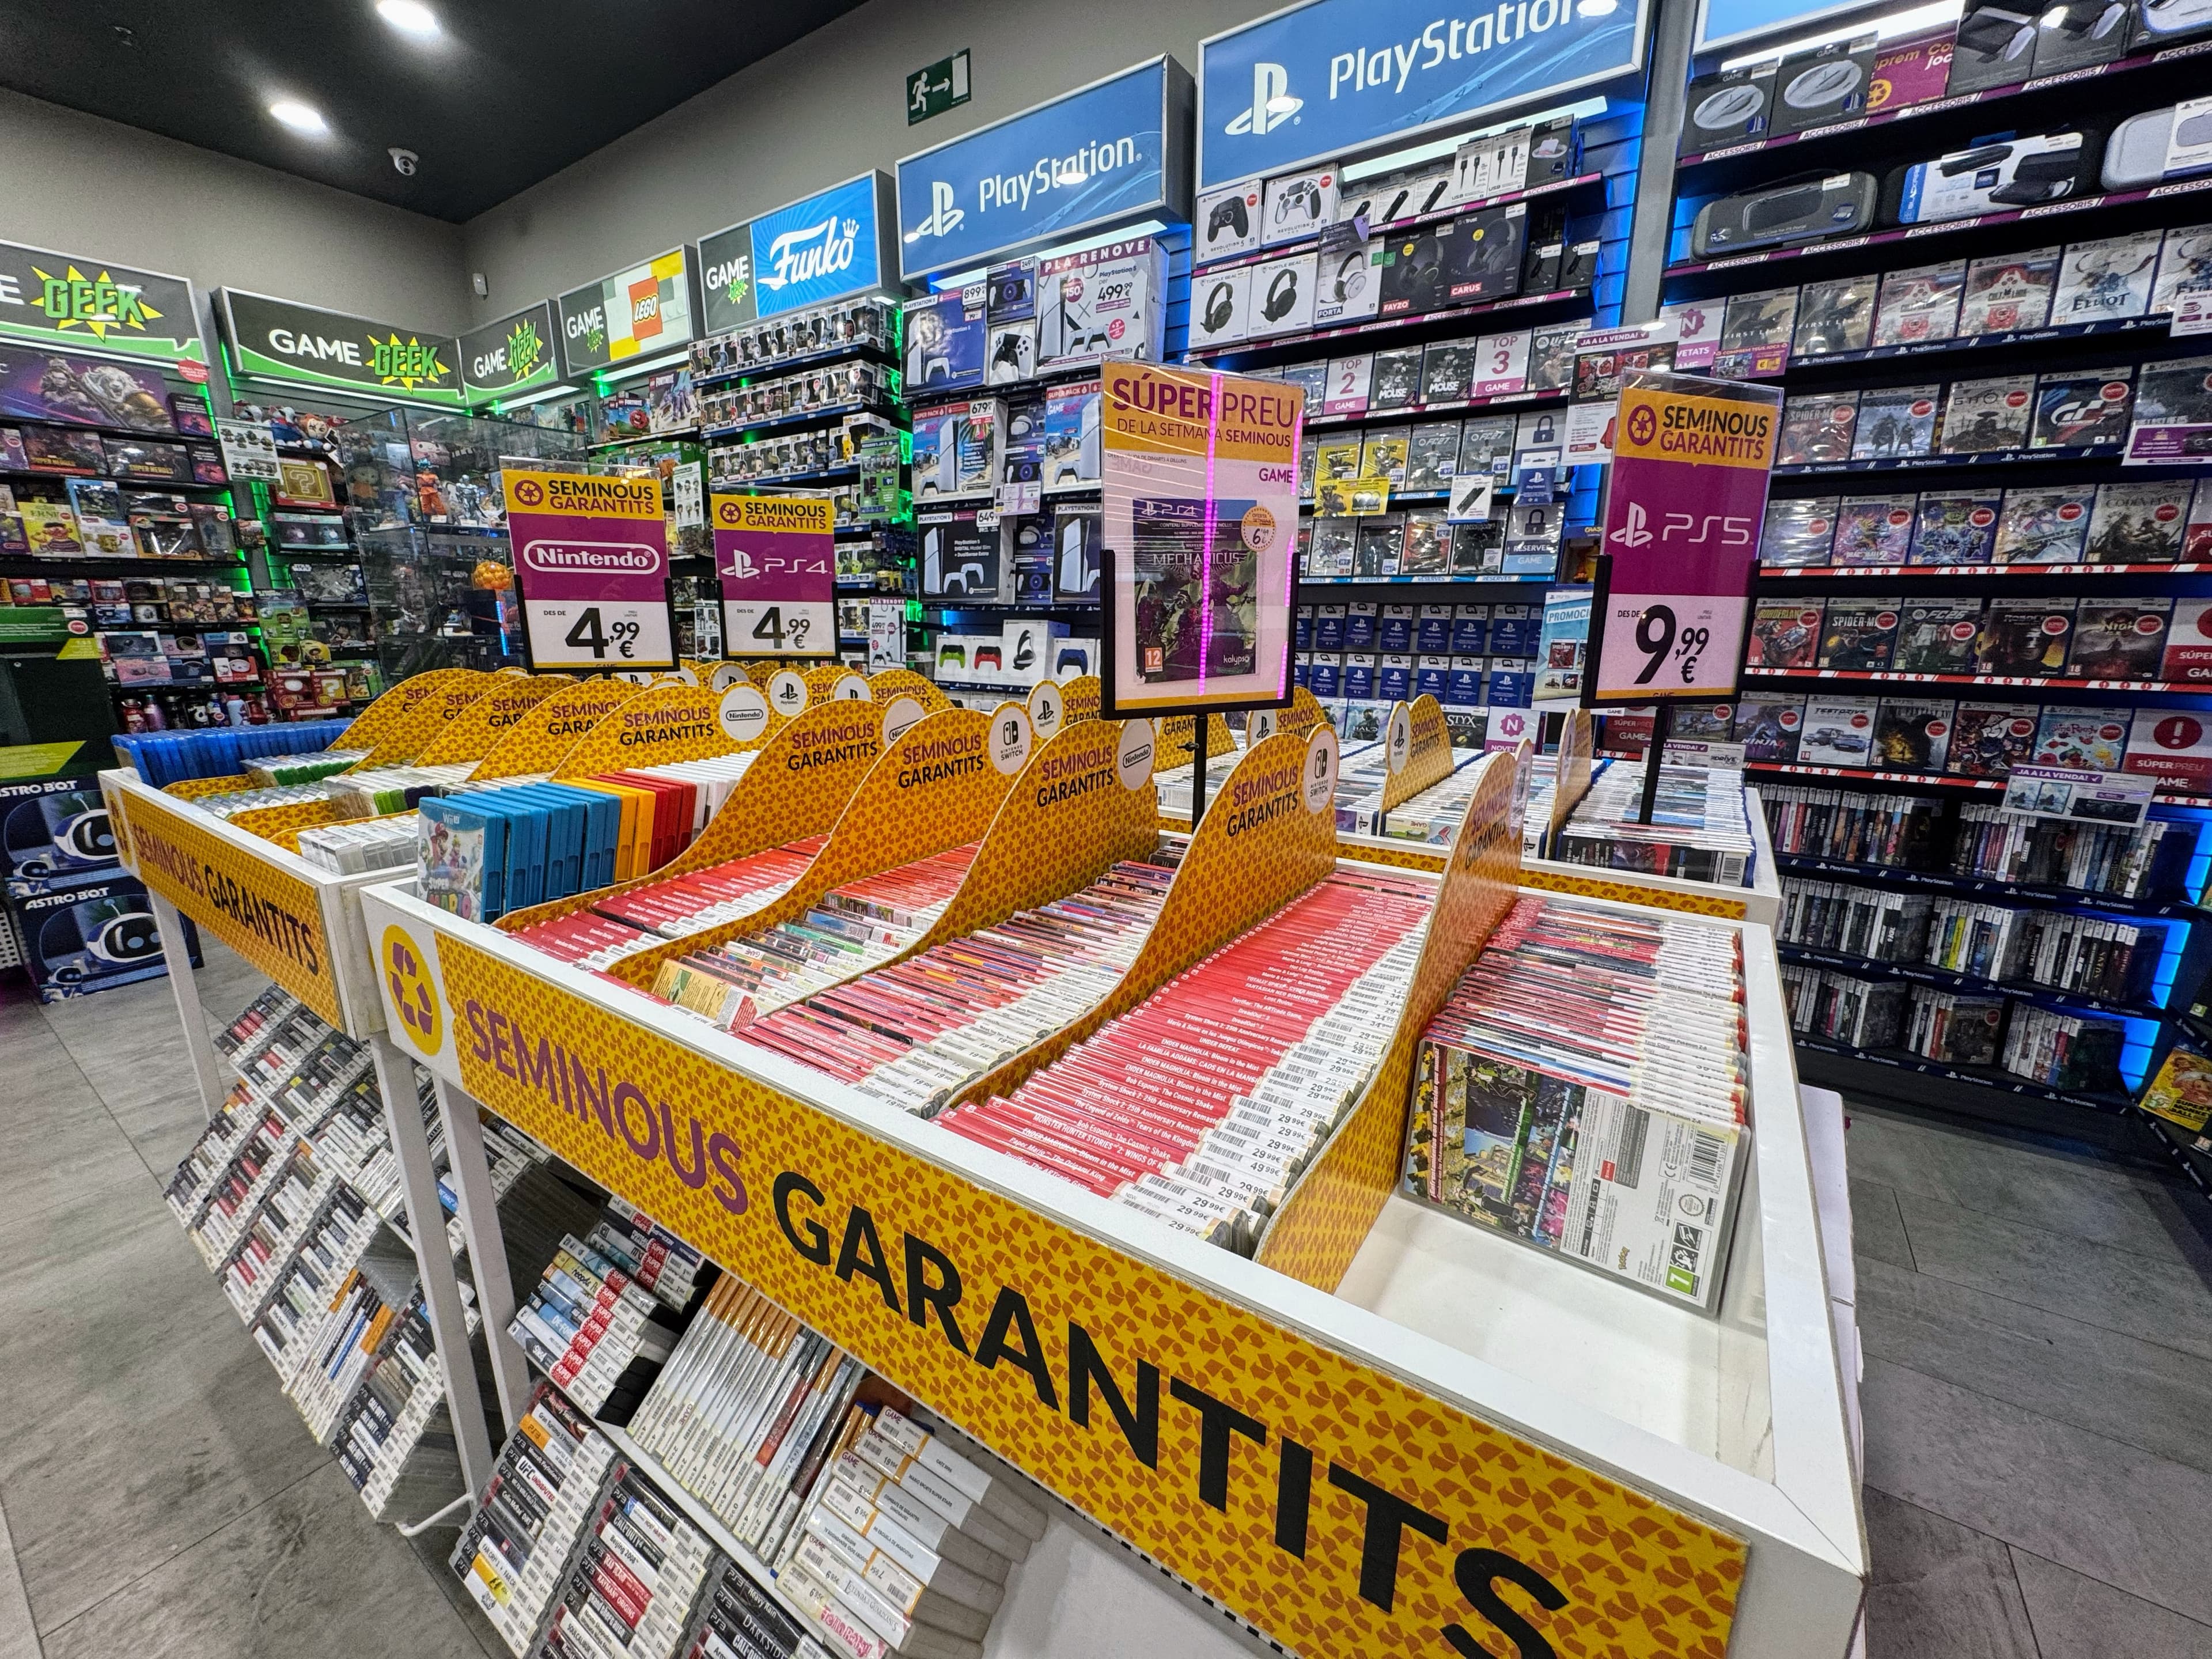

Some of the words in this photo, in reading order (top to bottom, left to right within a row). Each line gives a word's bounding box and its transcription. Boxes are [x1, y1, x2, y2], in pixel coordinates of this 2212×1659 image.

[2028, 69, 2096, 90] ACCESSORIS
[1910, 96, 1971, 115] ACCESSORIS
[1707, 143, 1758, 159] ACCESSORIS
[979, 137, 1135, 213] PlayStation
[2026, 200, 2094, 218] ACCESSORIS
[757, 216, 855, 291] Funko
[1045, 260, 1071, 272] PLA
[1080, 240, 1145, 264] RENOVE
[1806, 239, 1862, 254] ACCESSORIS
[706, 255, 749, 291] GAME
[729, 280, 747, 303] GEEK
[1099, 267, 1132, 278] PlayStation
[1452, 284, 1481, 295] CARUS
[44, 279, 145, 323] GEEK
[634, 294, 658, 322] LEGO
[1384, 301, 1408, 311] FAYZO
[1319, 308, 1342, 316] FORTA
[567, 307, 604, 340] GAME
[587, 328, 603, 351] GEEK
[474, 347, 507, 379] GAME
[508, 320, 539, 374] GEEK
[1492, 336, 1518, 348] TOP
[268, 329, 362, 366] GAME
[373, 344, 440, 378] GEEK
[1492, 350, 1510, 374] 3
[1340, 359, 1361, 370] TOP
[1340, 373, 1355, 394] 2
[1378, 388, 1407, 400] MOUSE
[1429, 381, 1459, 393] MOUSE
[1485, 382, 1509, 392] GAME
[1112, 373, 1213, 420] SÚPER
[1222, 392, 1294, 427] PREU
[1335, 402, 1356, 410] GAME
[1662, 405, 1769, 438] SEMINOUS
[1118, 418, 1135, 432] DE
[1141, 421, 1157, 434] LA
[1226, 429, 1290, 447] SEMINOUS
[1660, 430, 1764, 460] GARANTITS
[1259, 468, 1293, 483] GAME
[548, 479, 653, 500] SEMINOUS
[550, 497, 654, 514] GARANTITS
[745, 502, 826, 517] SEMINOUS
[746, 515, 826, 529] GARANTITS
[1662, 513, 1751, 544] PS5
[536, 547, 649, 568] Nintendo
[764, 557, 828, 574] PS4
[1153, 552, 1240, 565] MECHAICUS
[1146, 650, 1161, 666] 12
[1223, 654, 1250, 665] kalypso
[624, 706, 711, 728] SEMINOUS
[727, 710, 762, 720] Nintendo
[1278, 707, 1314, 729] SEMINOUS
[1446, 715, 1475, 728] STYX
[619, 724, 715, 746] GARANTITS
[791, 724, 875, 750] SEMINOUS
[1411, 715, 1438, 738] SEMINOUS
[903, 734, 982, 766] SEMINOUS
[1001, 749, 1023, 761] SWITCH
[1410, 732, 1440, 759] GARANTITS
[787, 741, 877, 772] GARANTITS
[1041, 746, 1112, 782] SEMINOUS
[1123, 747, 1149, 766] Nintendo
[897, 754, 984, 789] GARANTITS
[2054, 772, 2088, 782] VENDA!
[44, 780, 78, 793] BOT
[1037, 767, 1113, 808] GARANTITS
[1232, 765, 1298, 806] SEMINOUS
[1309, 783, 1328, 797] SWITCH
[1226, 790, 1298, 839] GARANTITS
[132, 823, 205, 898] SEMINOUS
[25, 893, 78, 910] ASTRO
[77, 887, 109, 899] BOT
[204, 865, 319, 976] GARANTITS
[1287, 992, 1317, 1005] DIMENSION
[1162, 1037, 1179, 1048] ENDER
[1212, 1052, 1228, 1063] Bloom
[1236, 1059, 1244, 1068] the
[1247, 1063, 1259, 1072] Mist
[1199, 1036, 1217, 1047] UNDER
[1218, 1041, 1239, 1054] DEFEAT
[1138, 1041, 1146, 1050] LA
[1147, 1044, 1169, 1057] FAMILIA
[1199, 1060, 1215, 1071] CAOS
[1217, 1066, 1225, 1074] EN
[1226, 1069, 1234, 1077] LA
[1126, 1075, 1136, 1085] Bob
[1138, 1080, 1160, 1094] Esponja:
[1162, 1088, 1172, 1097] The
[1173, 1092, 1194, 1104] Cosmic
[1196, 1099, 1213, 1111] Shake
[465, 998, 750, 1216] SEMINOUS
[1641, 1103, 1665, 1113] Leyendas
[1074, 1098, 1084, 1108] The
[1086, 1103, 1105, 1116] Legend
[1137, 1122, 1152, 1133] Tears
[1162, 1131, 1171, 1140] the
[1033, 1113, 1061, 1130] MONSTER
[1063, 1124, 1086, 1140] HUNTER
[1126, 1149, 1146, 1163] WINGS
[1147, 1157, 1156, 1167] OF
[771, 1171, 1574, 1659] GARANTITS
[885, 1409, 903, 1424] GAME
[528, 1424, 542, 1440] PS3
[842, 1452, 859, 1468] GAME
[518, 1460, 536, 1479] UFC
[531, 1475, 555, 1502] UNDISPUTED
[610, 1535, 626, 1555] Beijing
[582, 1560, 595, 1575] PS3
[617, 1597, 635, 1619] ORIGINS
[717, 1590, 732, 1608] PS3
[728, 1570, 743, 1586] PS3
[748, 1588, 765, 1608] Heavy
[764, 1604, 777, 1619] Rain
